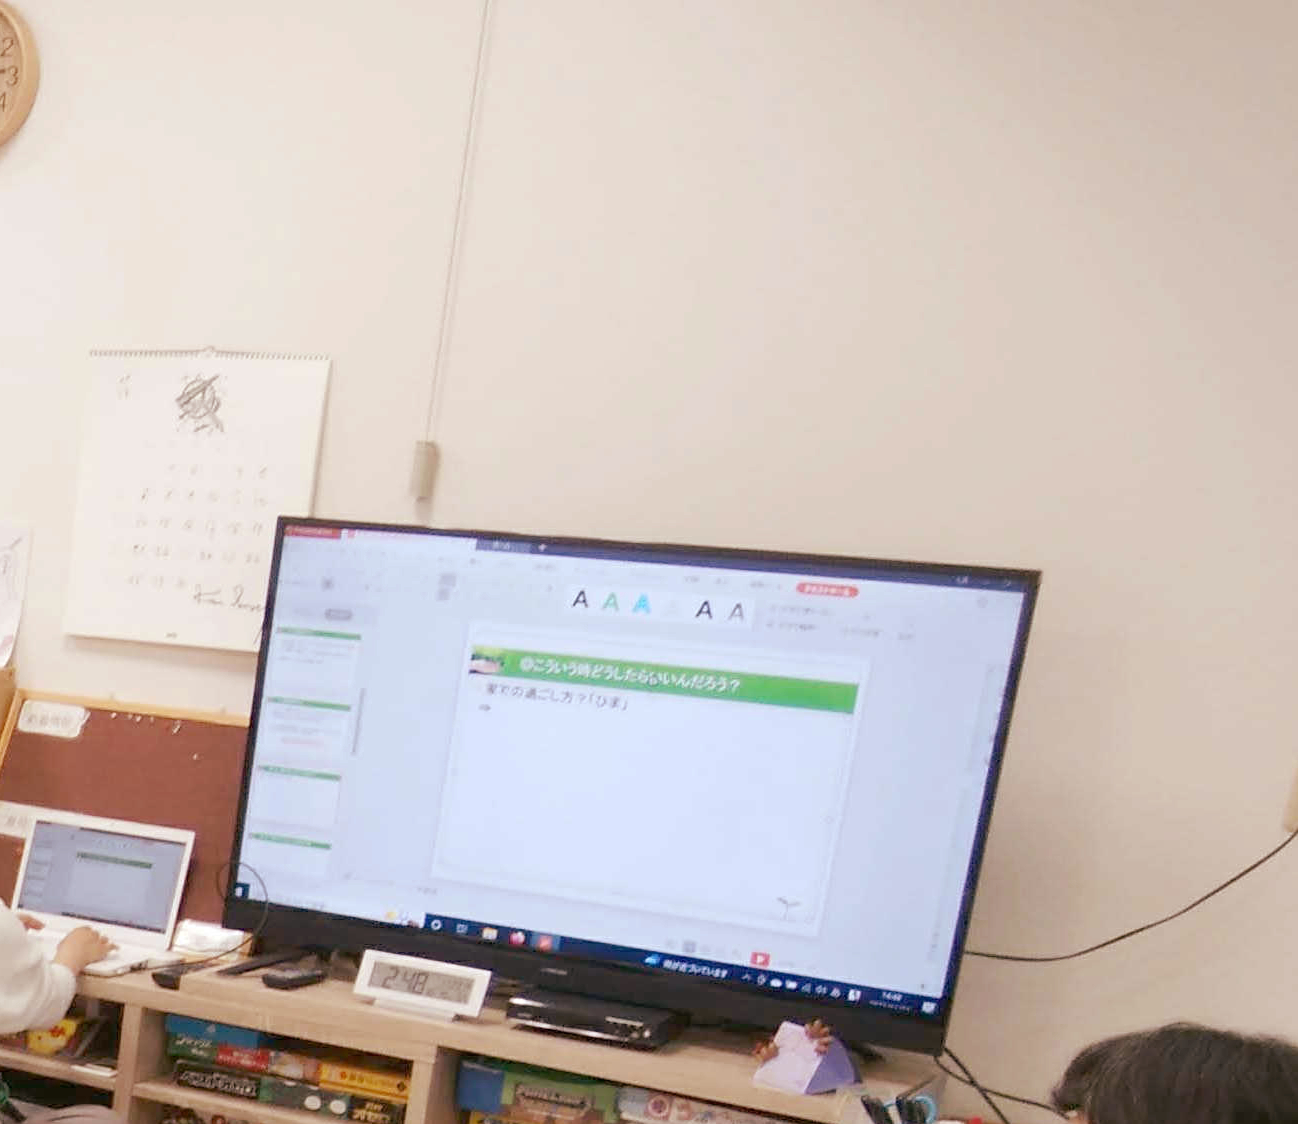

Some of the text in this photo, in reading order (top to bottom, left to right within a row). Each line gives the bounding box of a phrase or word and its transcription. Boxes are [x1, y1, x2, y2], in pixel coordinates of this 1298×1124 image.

[0, 37, 14, 57] 2
[6, 65, 19, 86] 3
[572, 589, 745, 621] A A A A A
